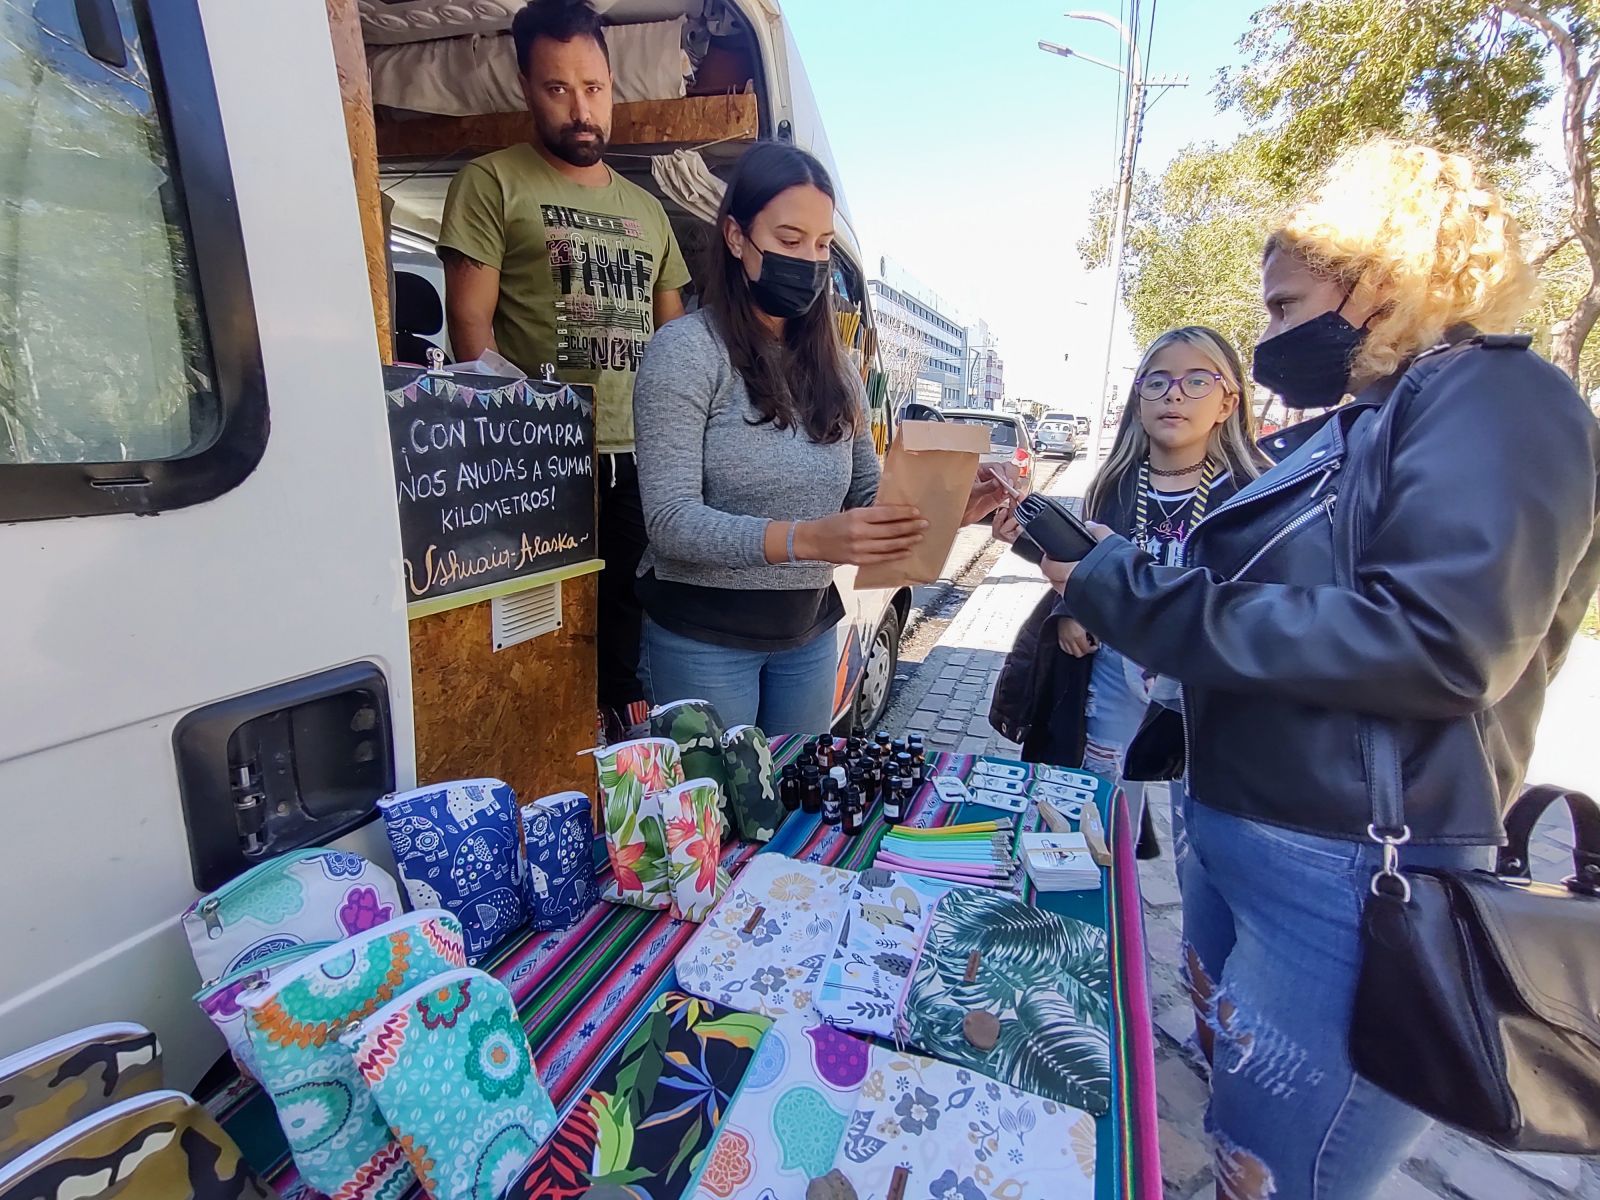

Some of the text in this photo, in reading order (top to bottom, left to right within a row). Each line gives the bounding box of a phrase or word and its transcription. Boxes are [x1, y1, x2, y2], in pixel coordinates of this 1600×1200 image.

[546, 210, 615, 229] STREET
[554, 301, 569, 361] URBAN
[398, 455, 593, 504] NOS AYUDAS A SUMAR
